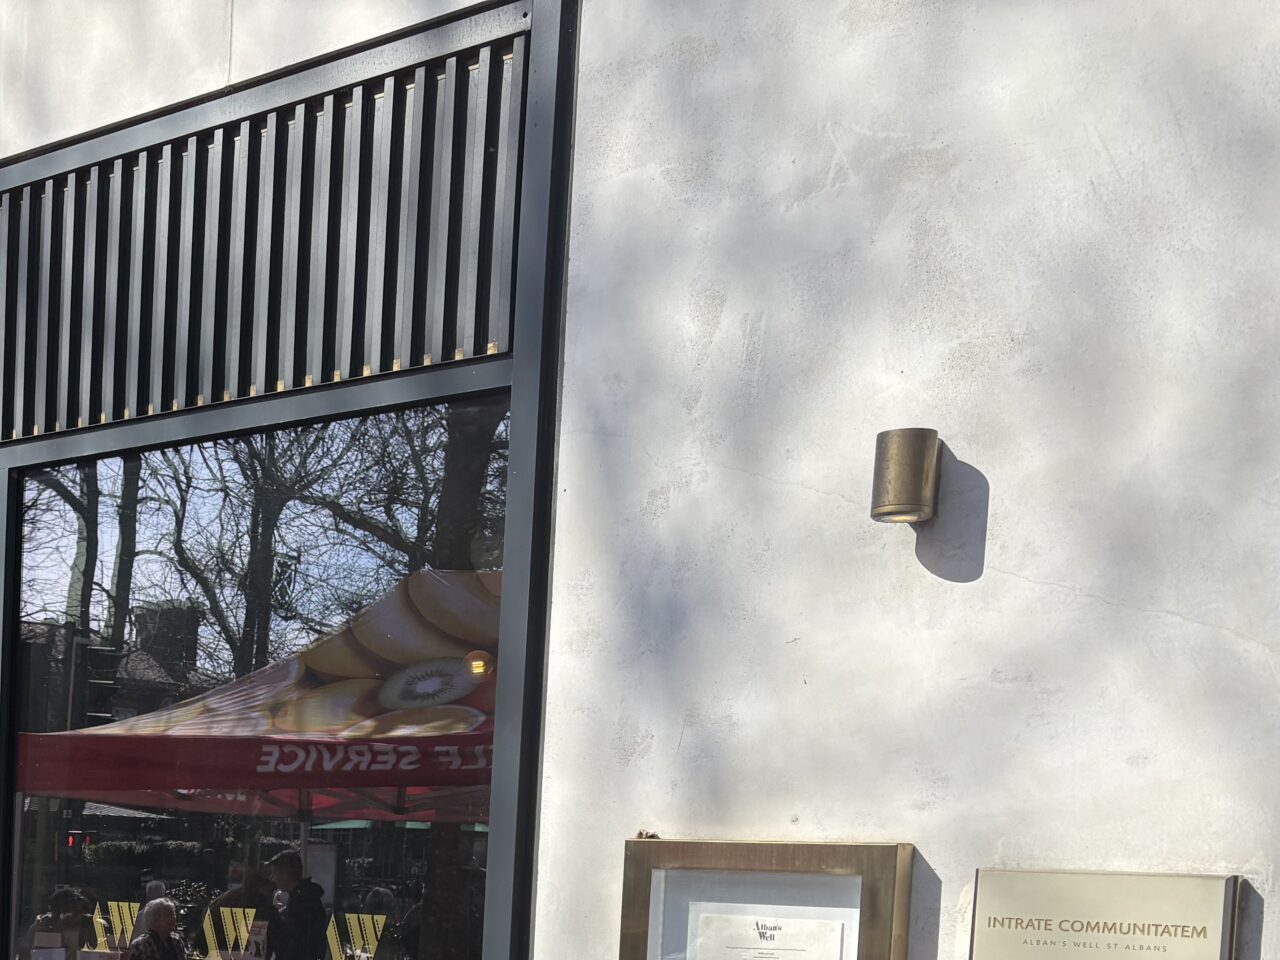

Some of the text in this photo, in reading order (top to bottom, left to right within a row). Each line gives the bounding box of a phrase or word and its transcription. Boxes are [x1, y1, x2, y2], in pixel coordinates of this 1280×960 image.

[987, 916, 1208, 939] INTRATE COMMUNITATEM
[758, 931, 775, 942] Well
[1022, 938, 1067, 948] ALBAN'S
[1073, 941, 1100, 949] WELL
[1124, 944, 1168, 953] ALBANS
